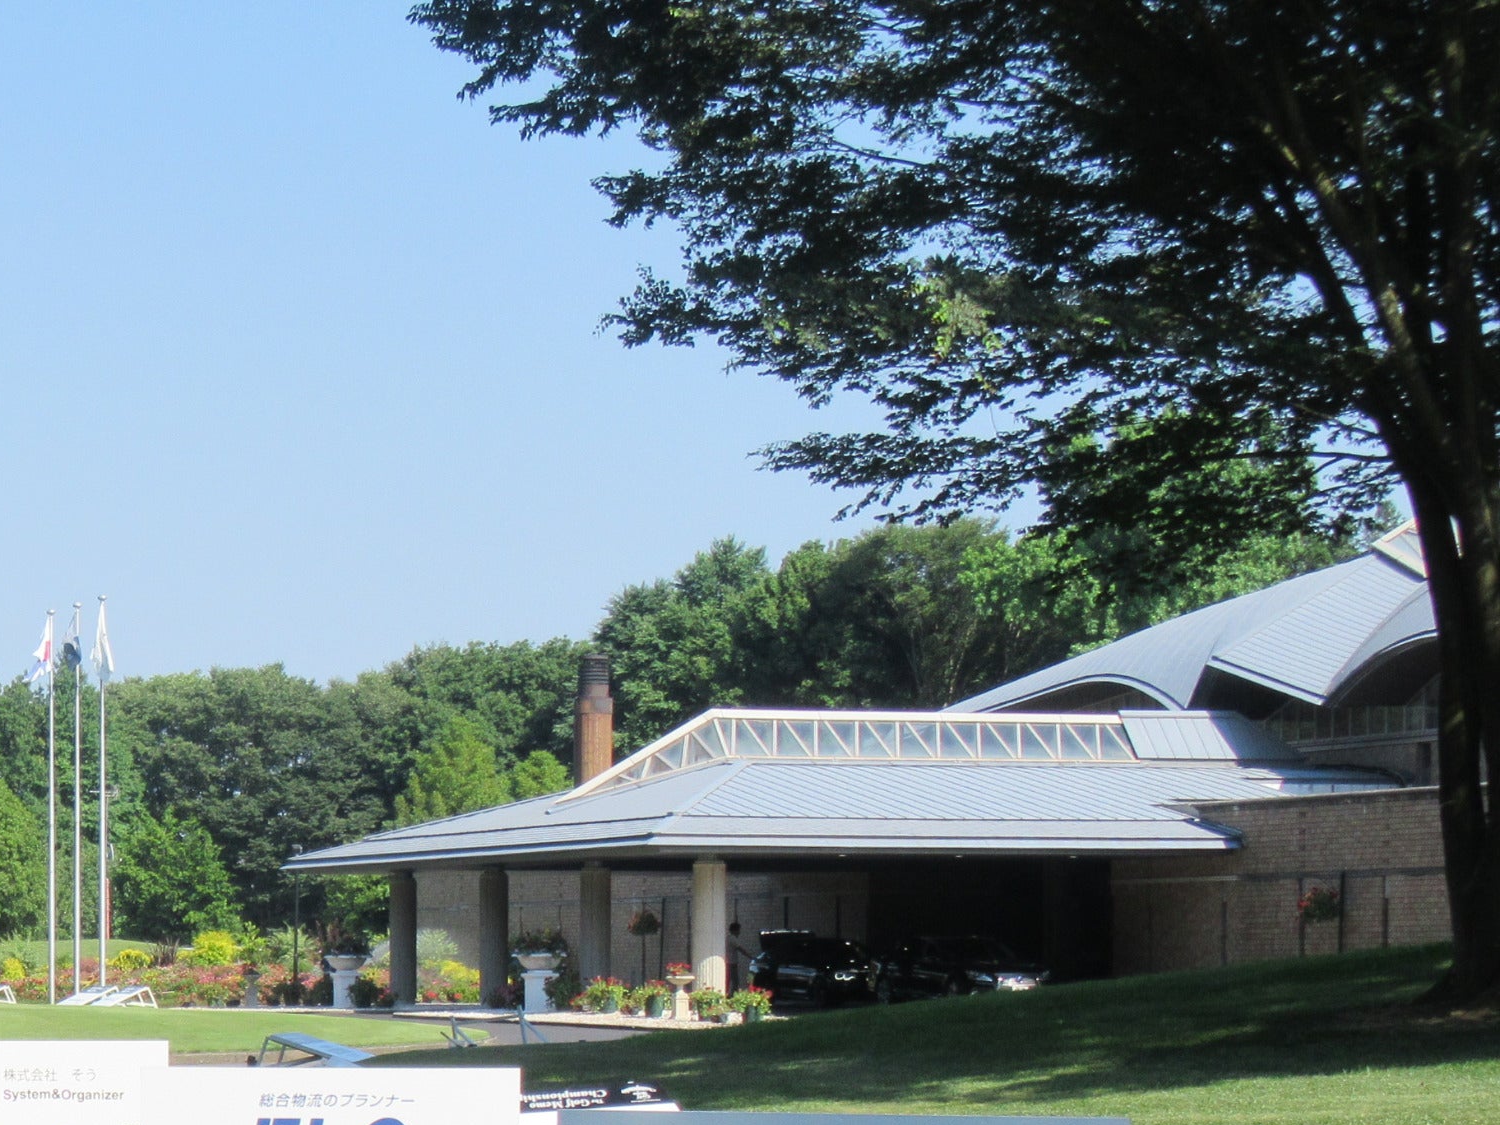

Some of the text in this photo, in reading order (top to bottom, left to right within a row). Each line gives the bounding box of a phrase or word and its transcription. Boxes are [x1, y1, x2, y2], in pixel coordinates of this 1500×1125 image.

[3, 1067, 58, 1082] 株式会社
[3, 1088, 125, 1103] System&Organizer
